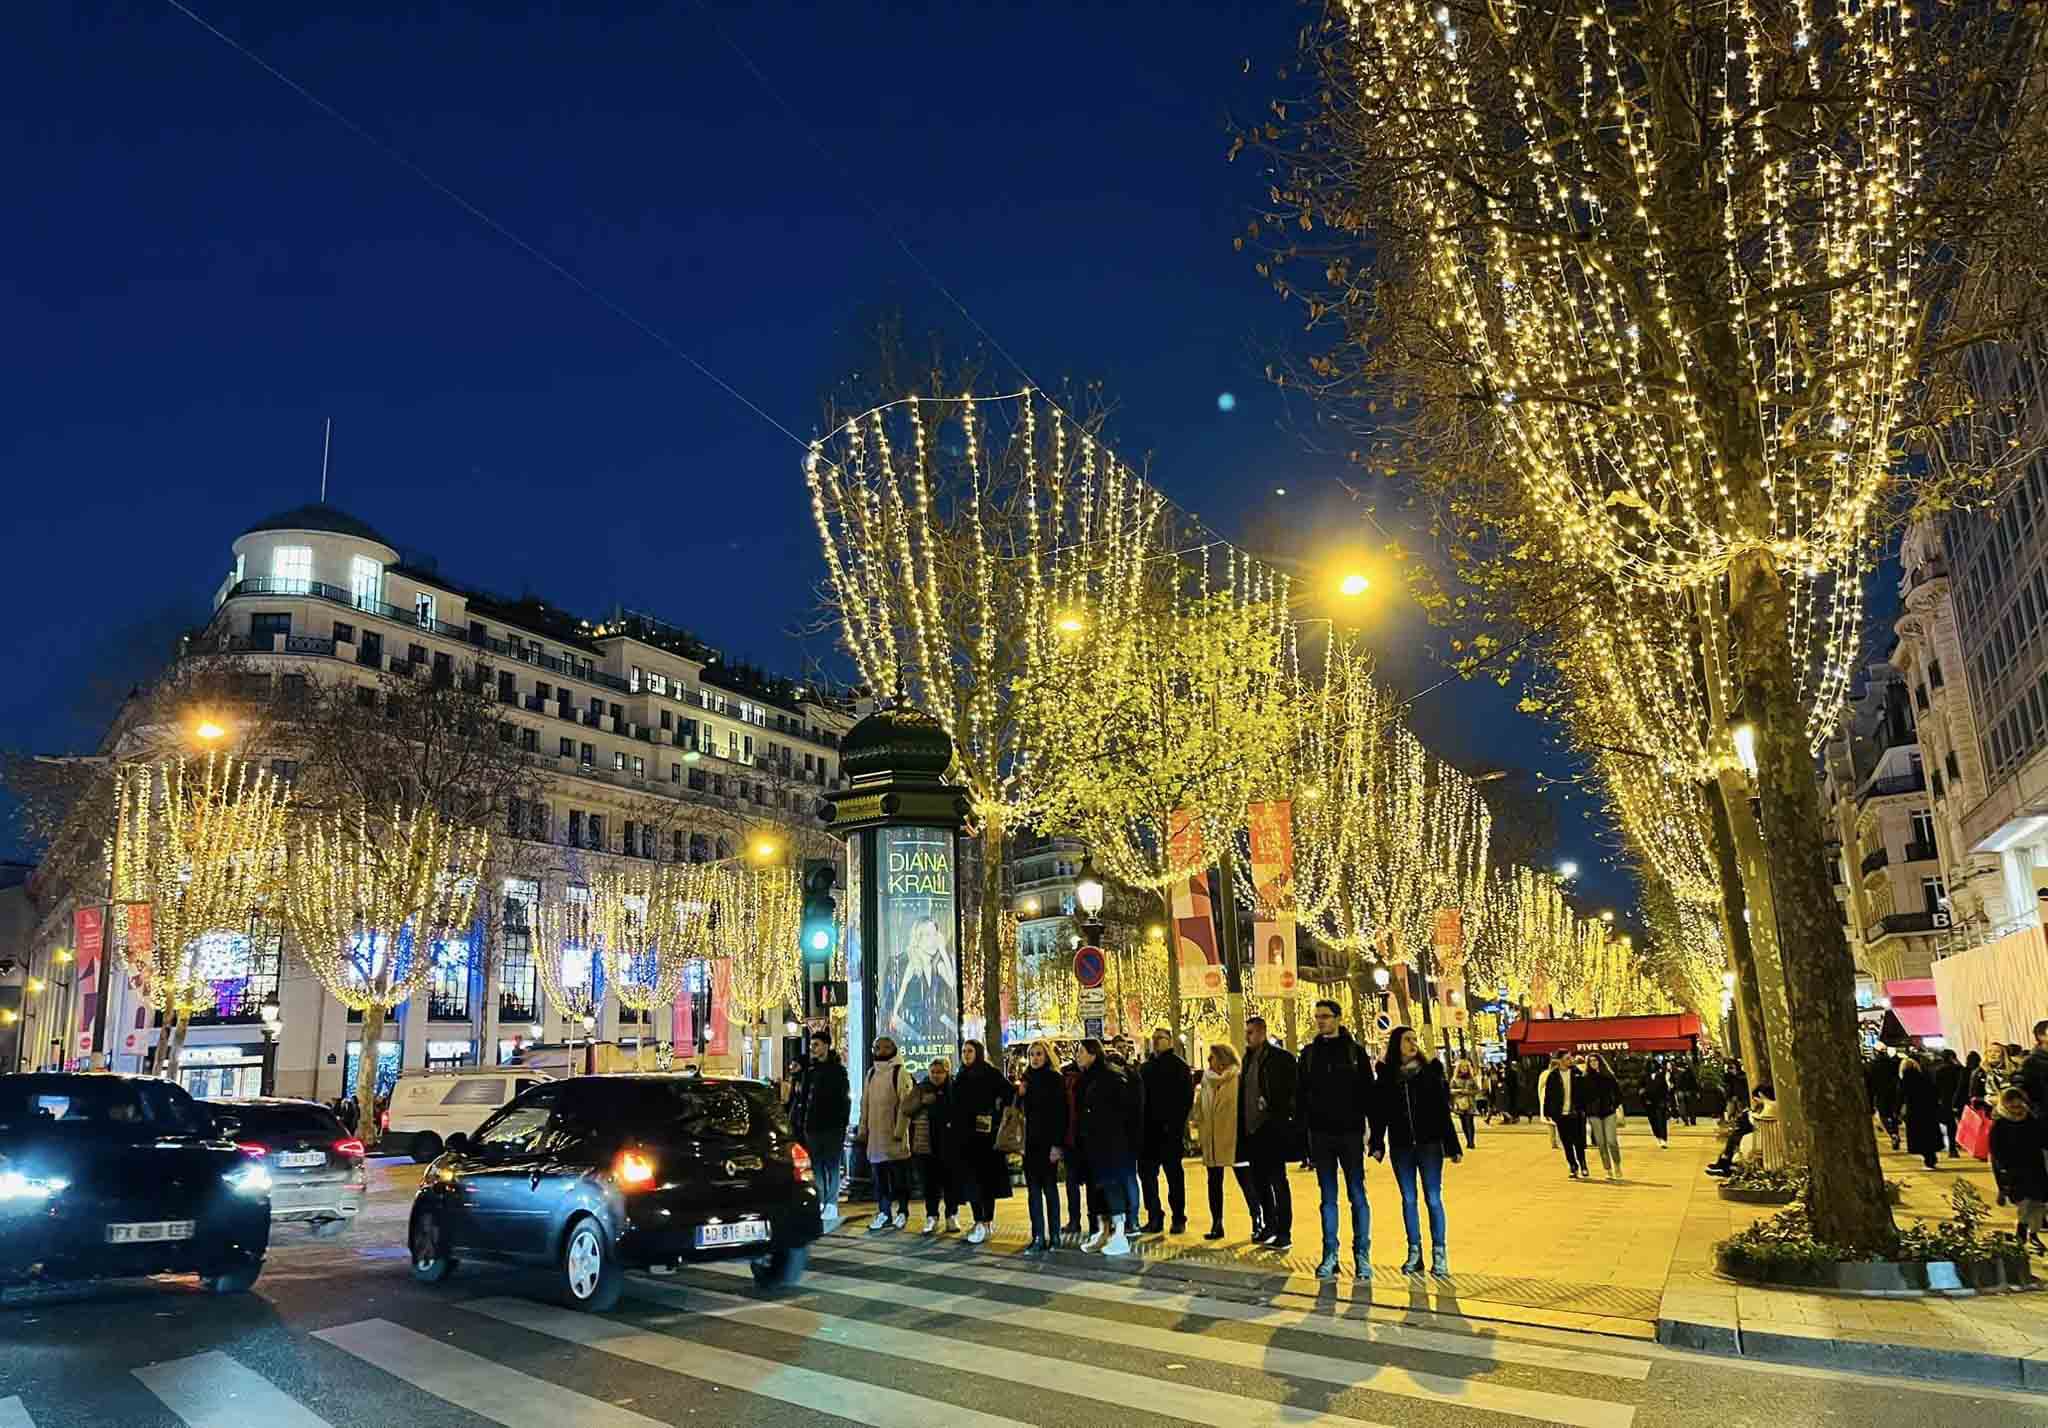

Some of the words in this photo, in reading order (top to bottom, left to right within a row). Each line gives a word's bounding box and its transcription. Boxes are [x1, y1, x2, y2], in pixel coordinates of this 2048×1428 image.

[889, 852, 949, 873] DIANA
[889, 874, 951, 895] KRALL
[1932, 913, 1950, 928] B
[1576, 1042, 1600, 1051] FIVE
[1601, 1041, 1630, 1051] GUYS
